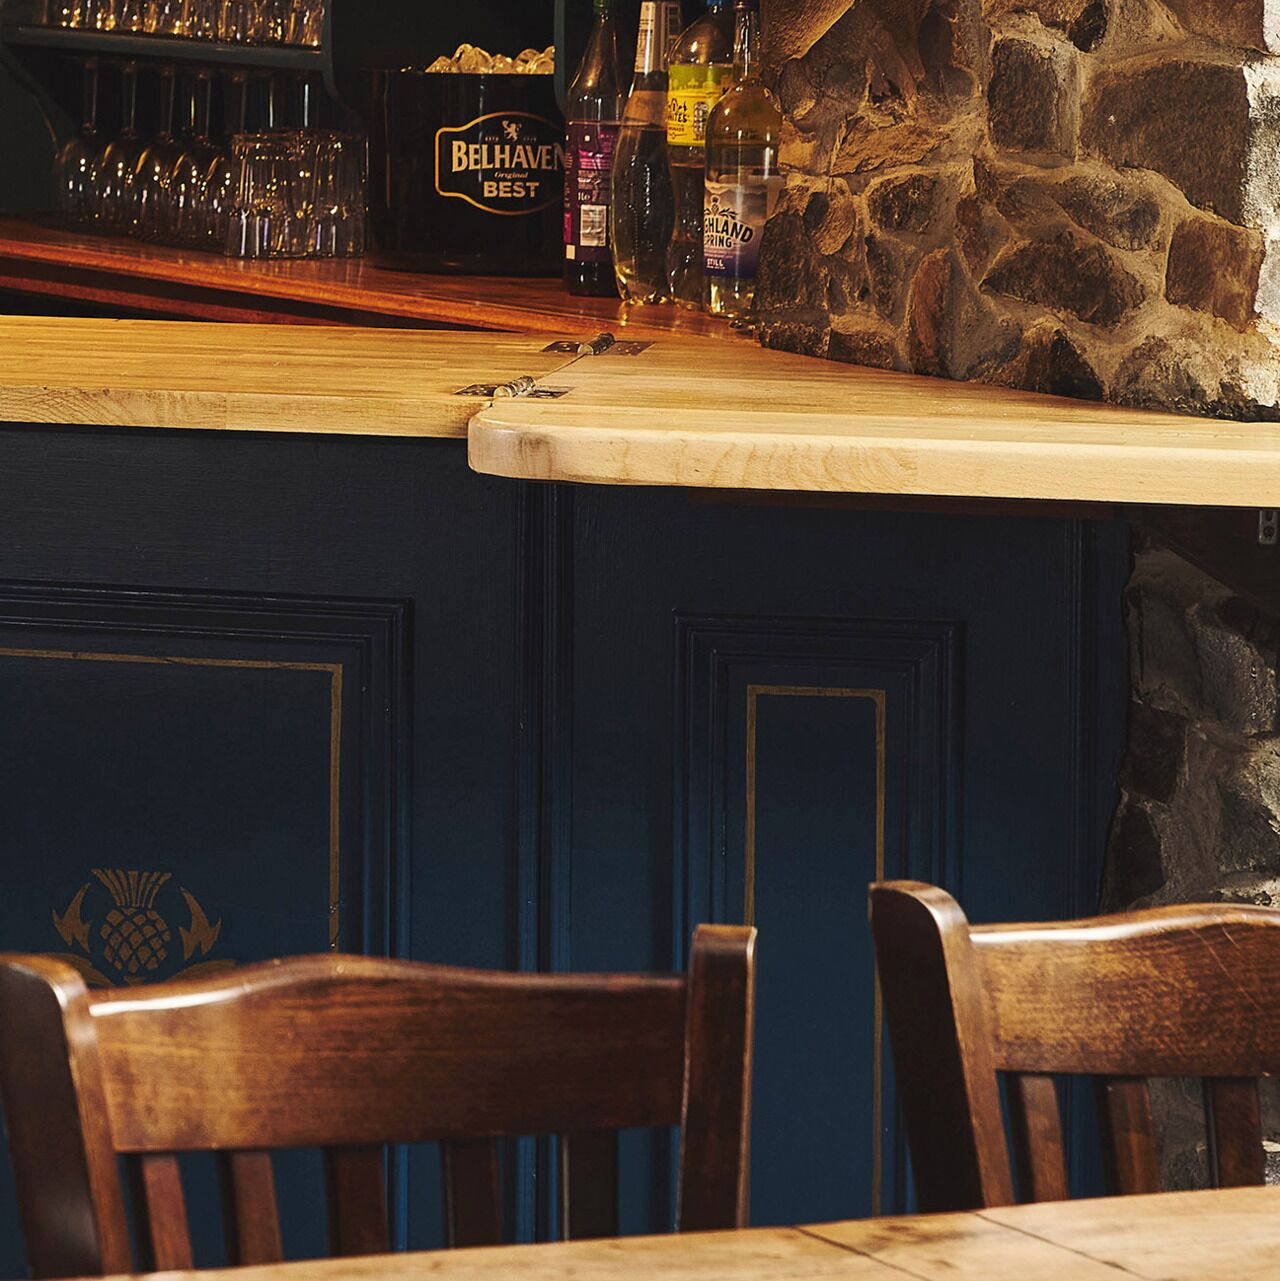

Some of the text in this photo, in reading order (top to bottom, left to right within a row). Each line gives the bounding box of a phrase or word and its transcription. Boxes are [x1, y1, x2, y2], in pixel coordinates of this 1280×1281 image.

[452, 140, 565, 173] BELHAVEN
[494, 171, 529, 180] Original
[483, 181, 540, 198] BEST
